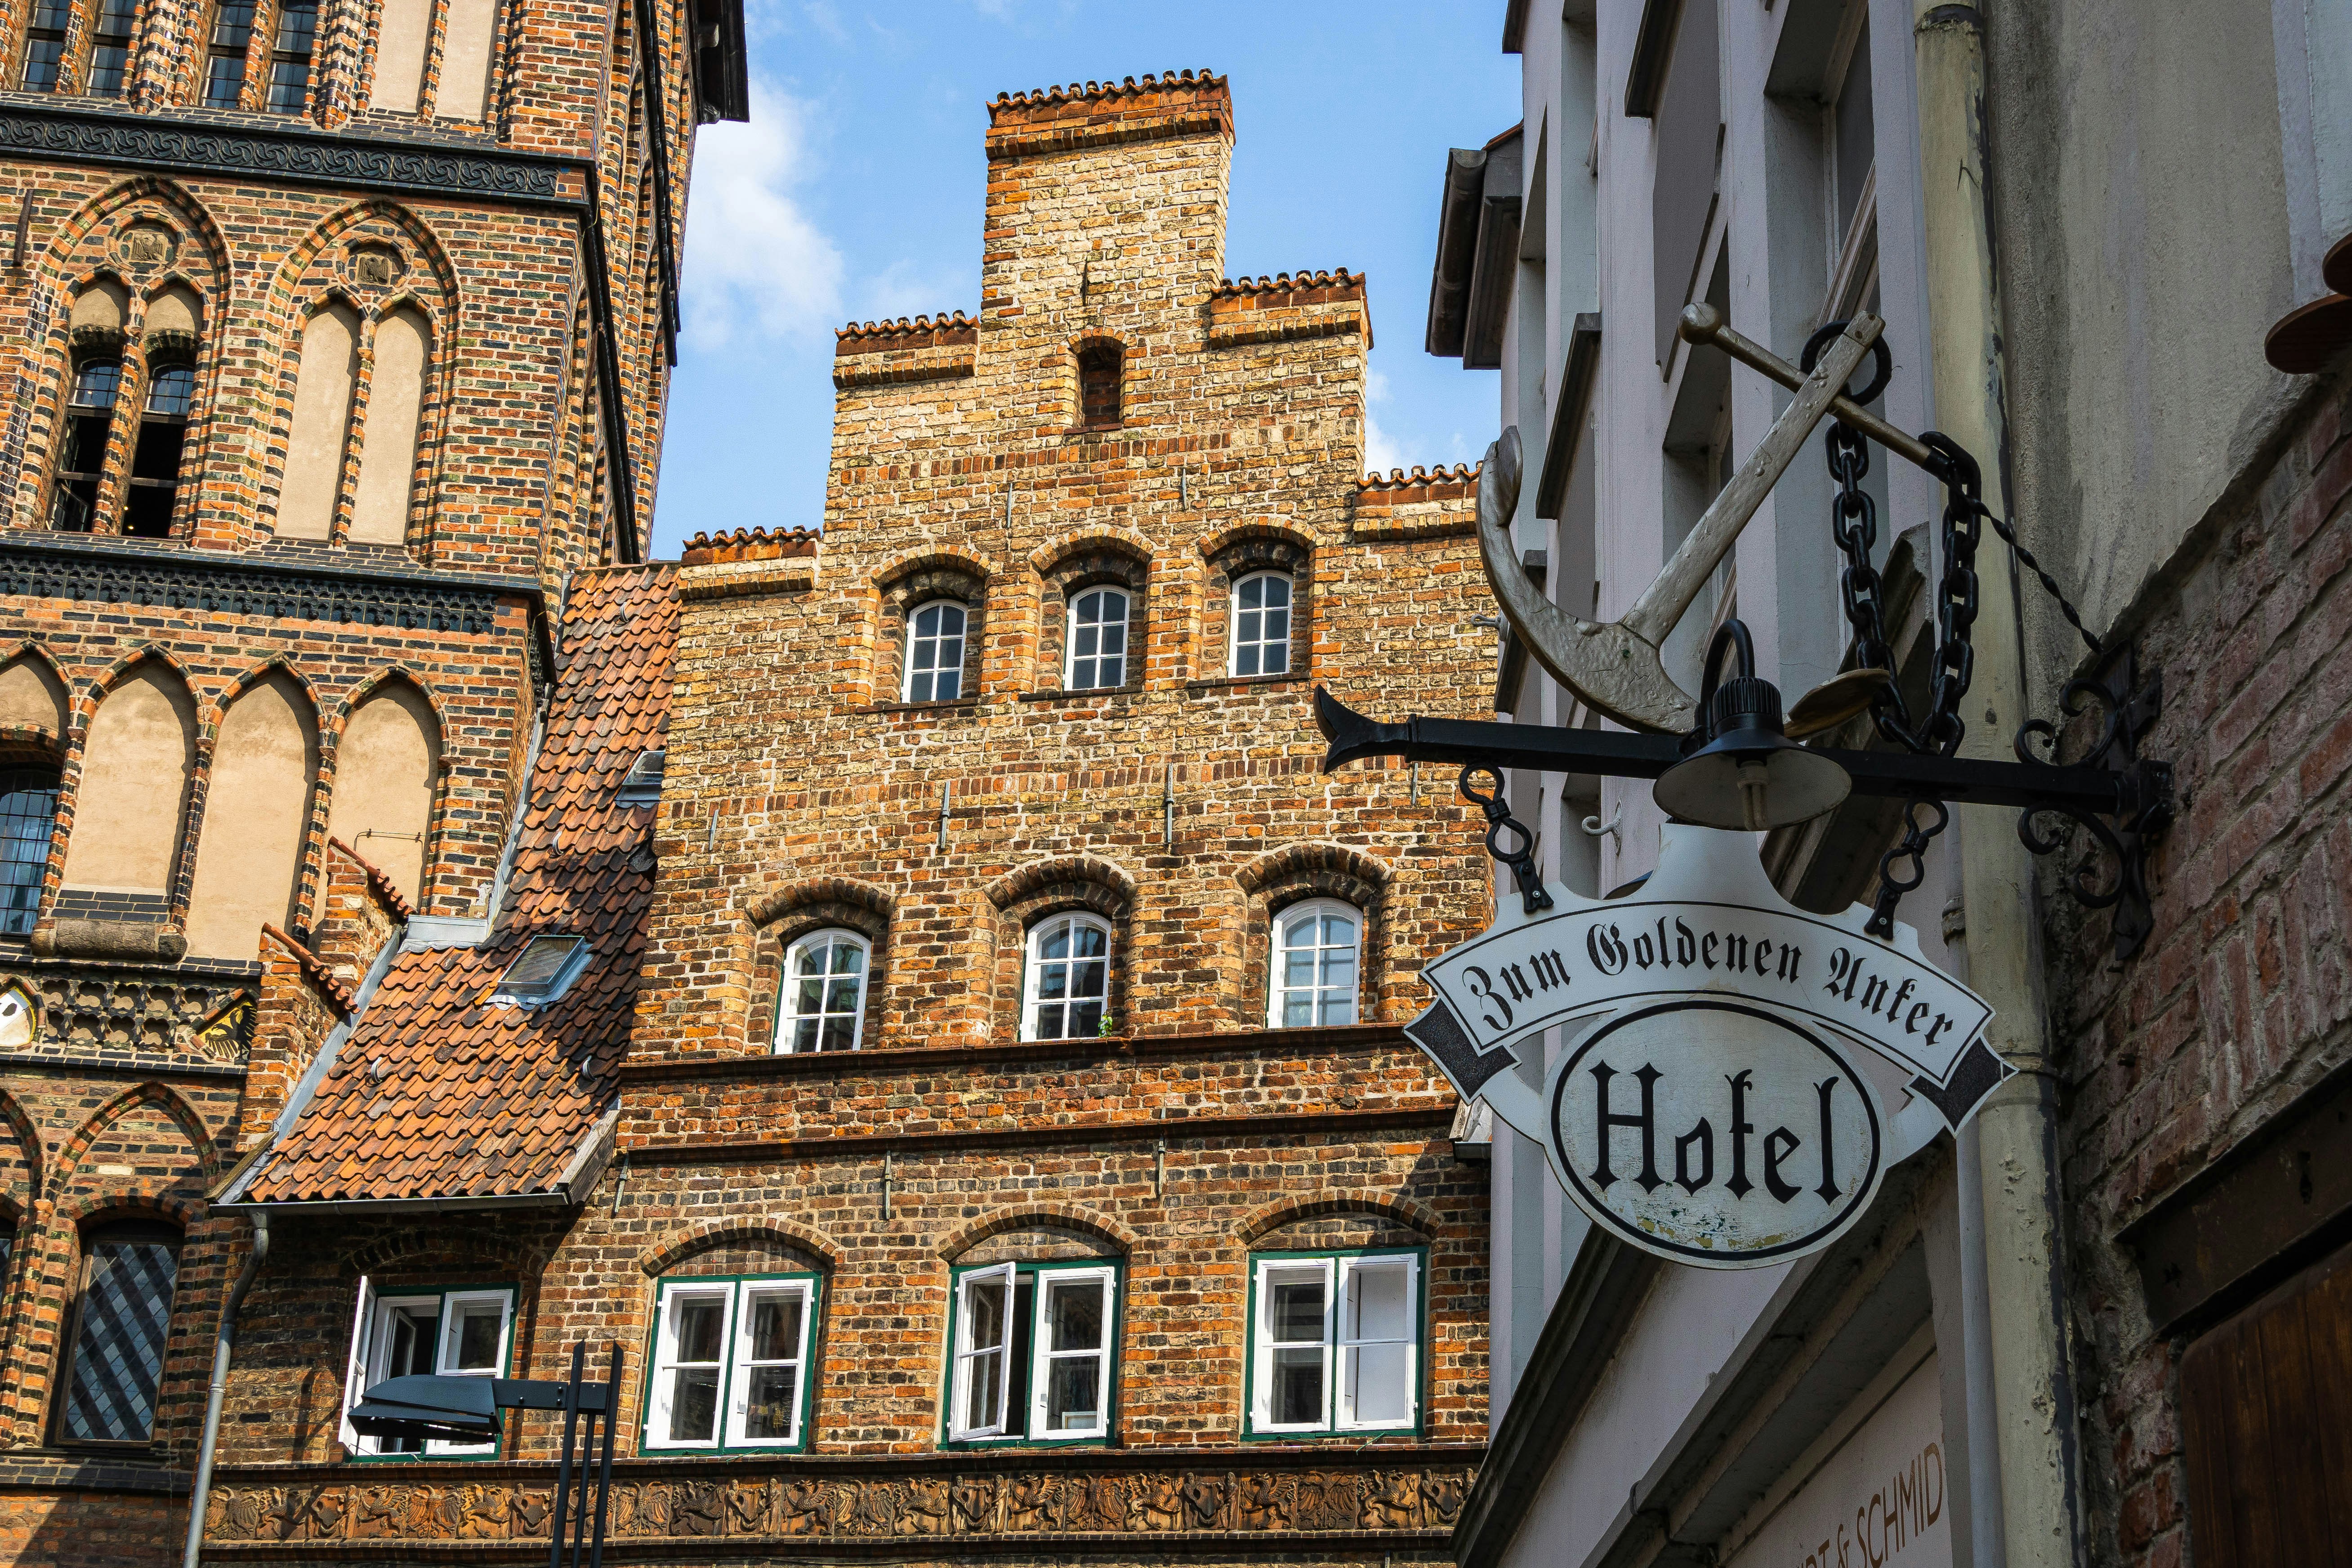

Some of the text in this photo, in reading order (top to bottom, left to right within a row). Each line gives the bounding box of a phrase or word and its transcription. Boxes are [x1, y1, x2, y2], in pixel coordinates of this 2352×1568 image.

[1462, 916, 1952, 1046] Zum Goldenen Anker
[1588, 1060, 1843, 1204] Hotel
[1857, 1433, 1945, 1568] SCHMID
